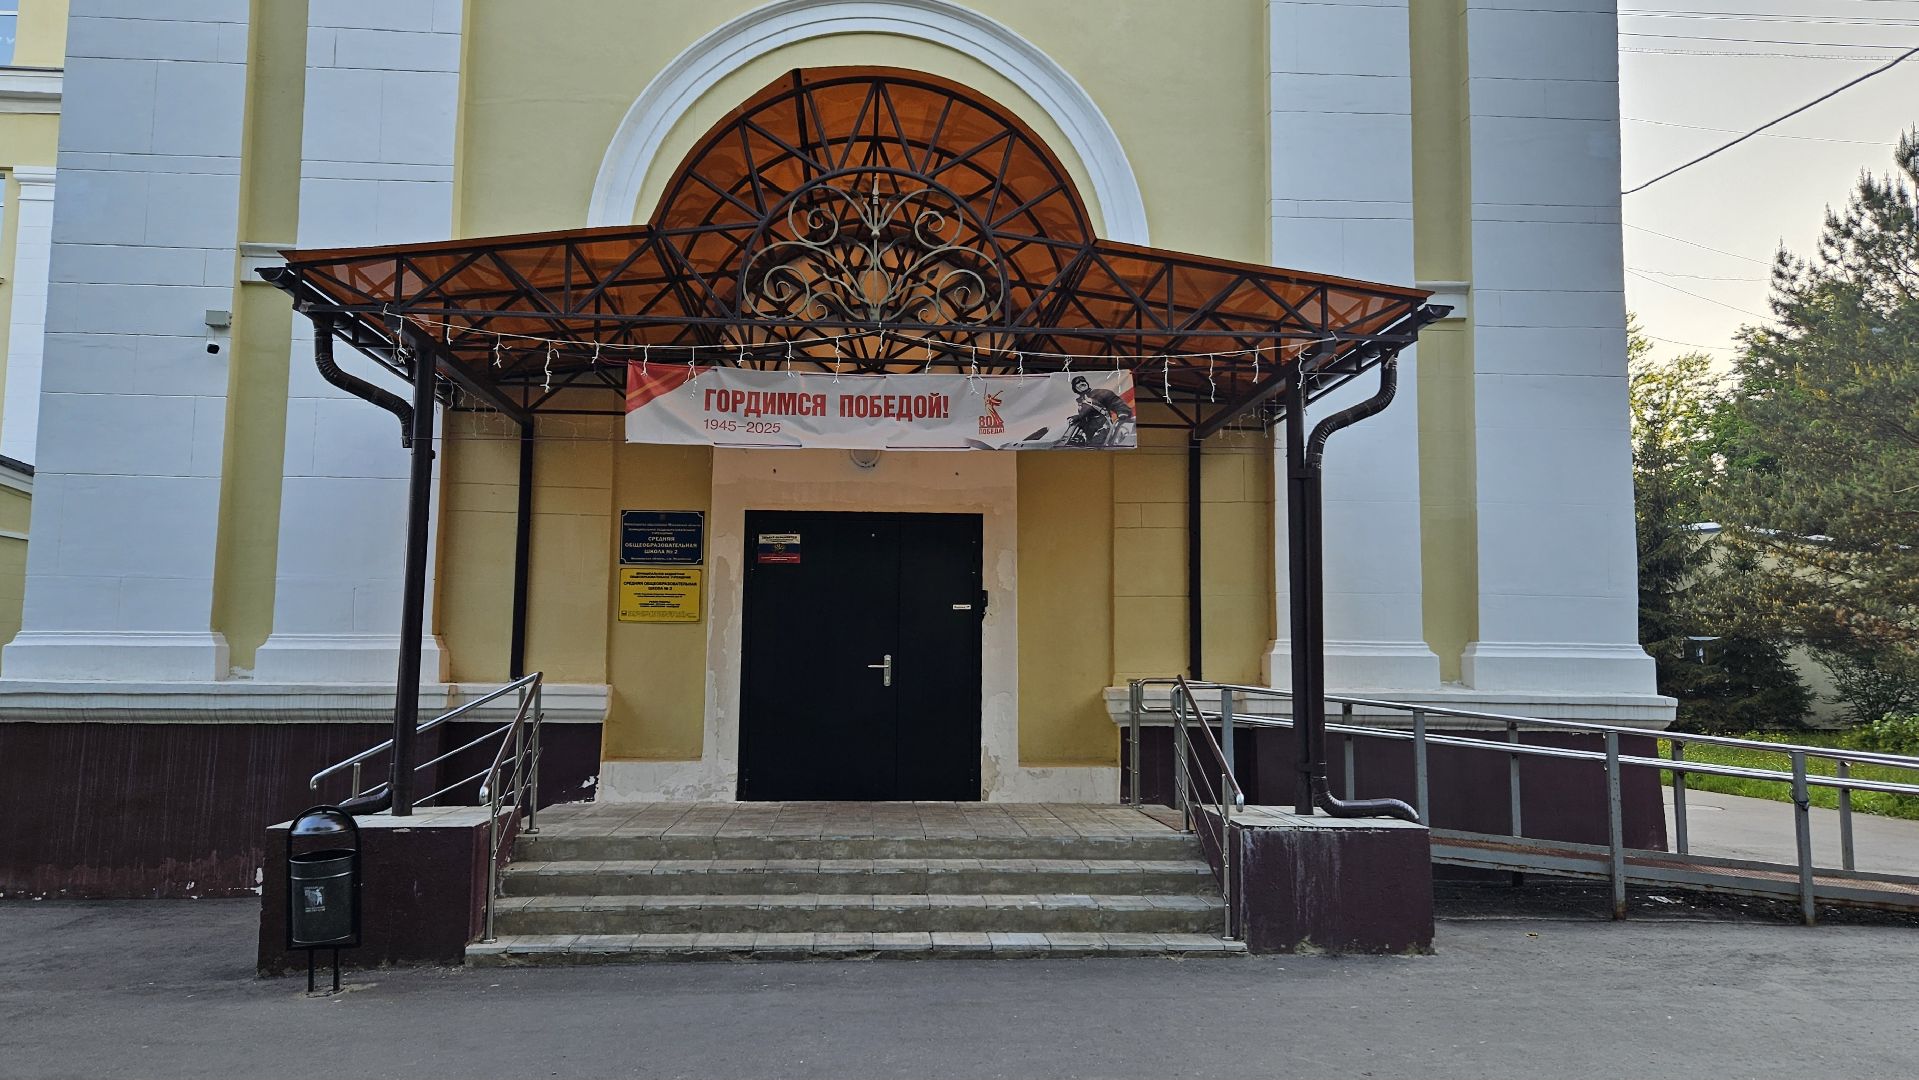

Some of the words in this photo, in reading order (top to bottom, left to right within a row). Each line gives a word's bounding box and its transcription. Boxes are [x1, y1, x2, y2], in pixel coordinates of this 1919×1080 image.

[704, 388, 826, 417] ГОРДИМСЯ
[839, 392, 949, 421] ПОБЕДОЙ!
[979, 416, 994, 427] 80
